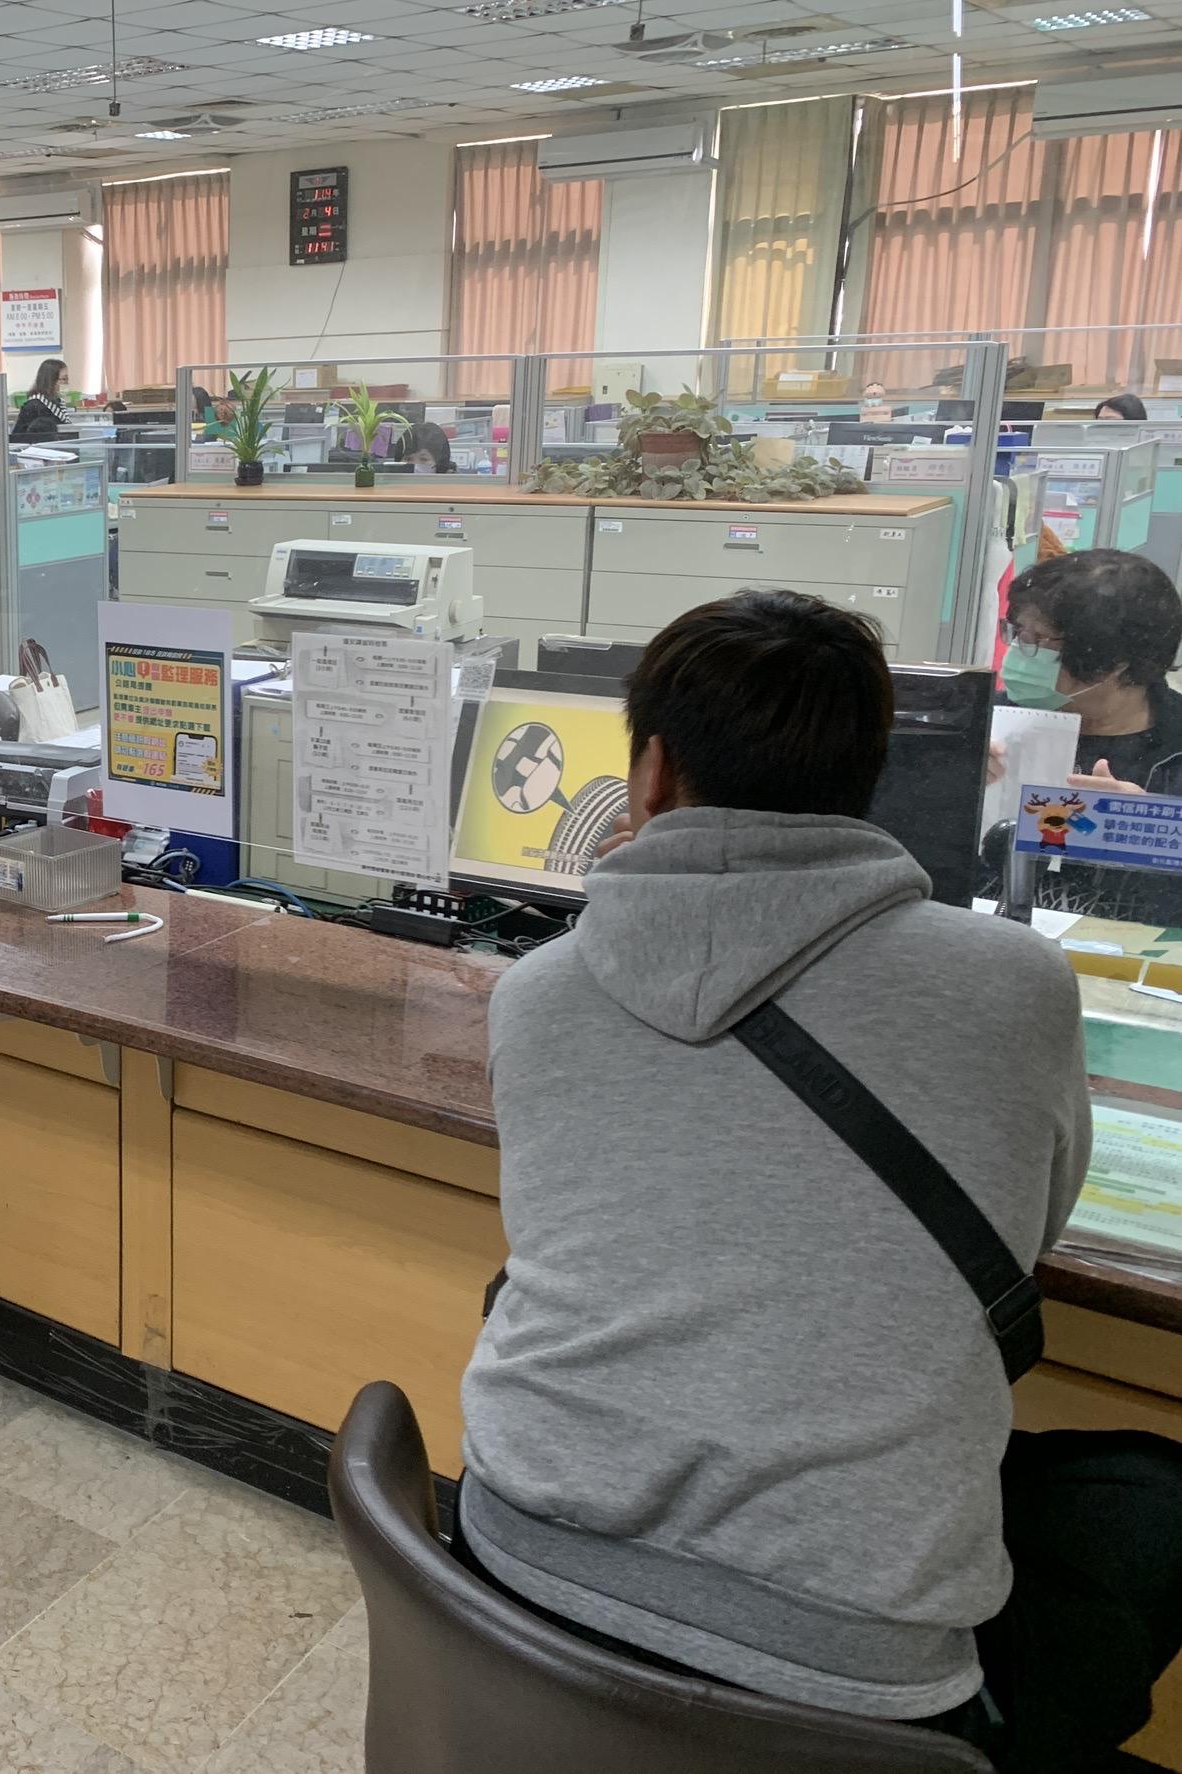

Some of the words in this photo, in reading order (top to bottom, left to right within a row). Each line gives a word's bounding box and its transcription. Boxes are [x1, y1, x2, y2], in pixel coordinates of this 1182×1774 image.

[112, 659, 136, 677] 小心
[161, 664, 218, 687] 監理服務
[144, 762, 166, 777] 165
